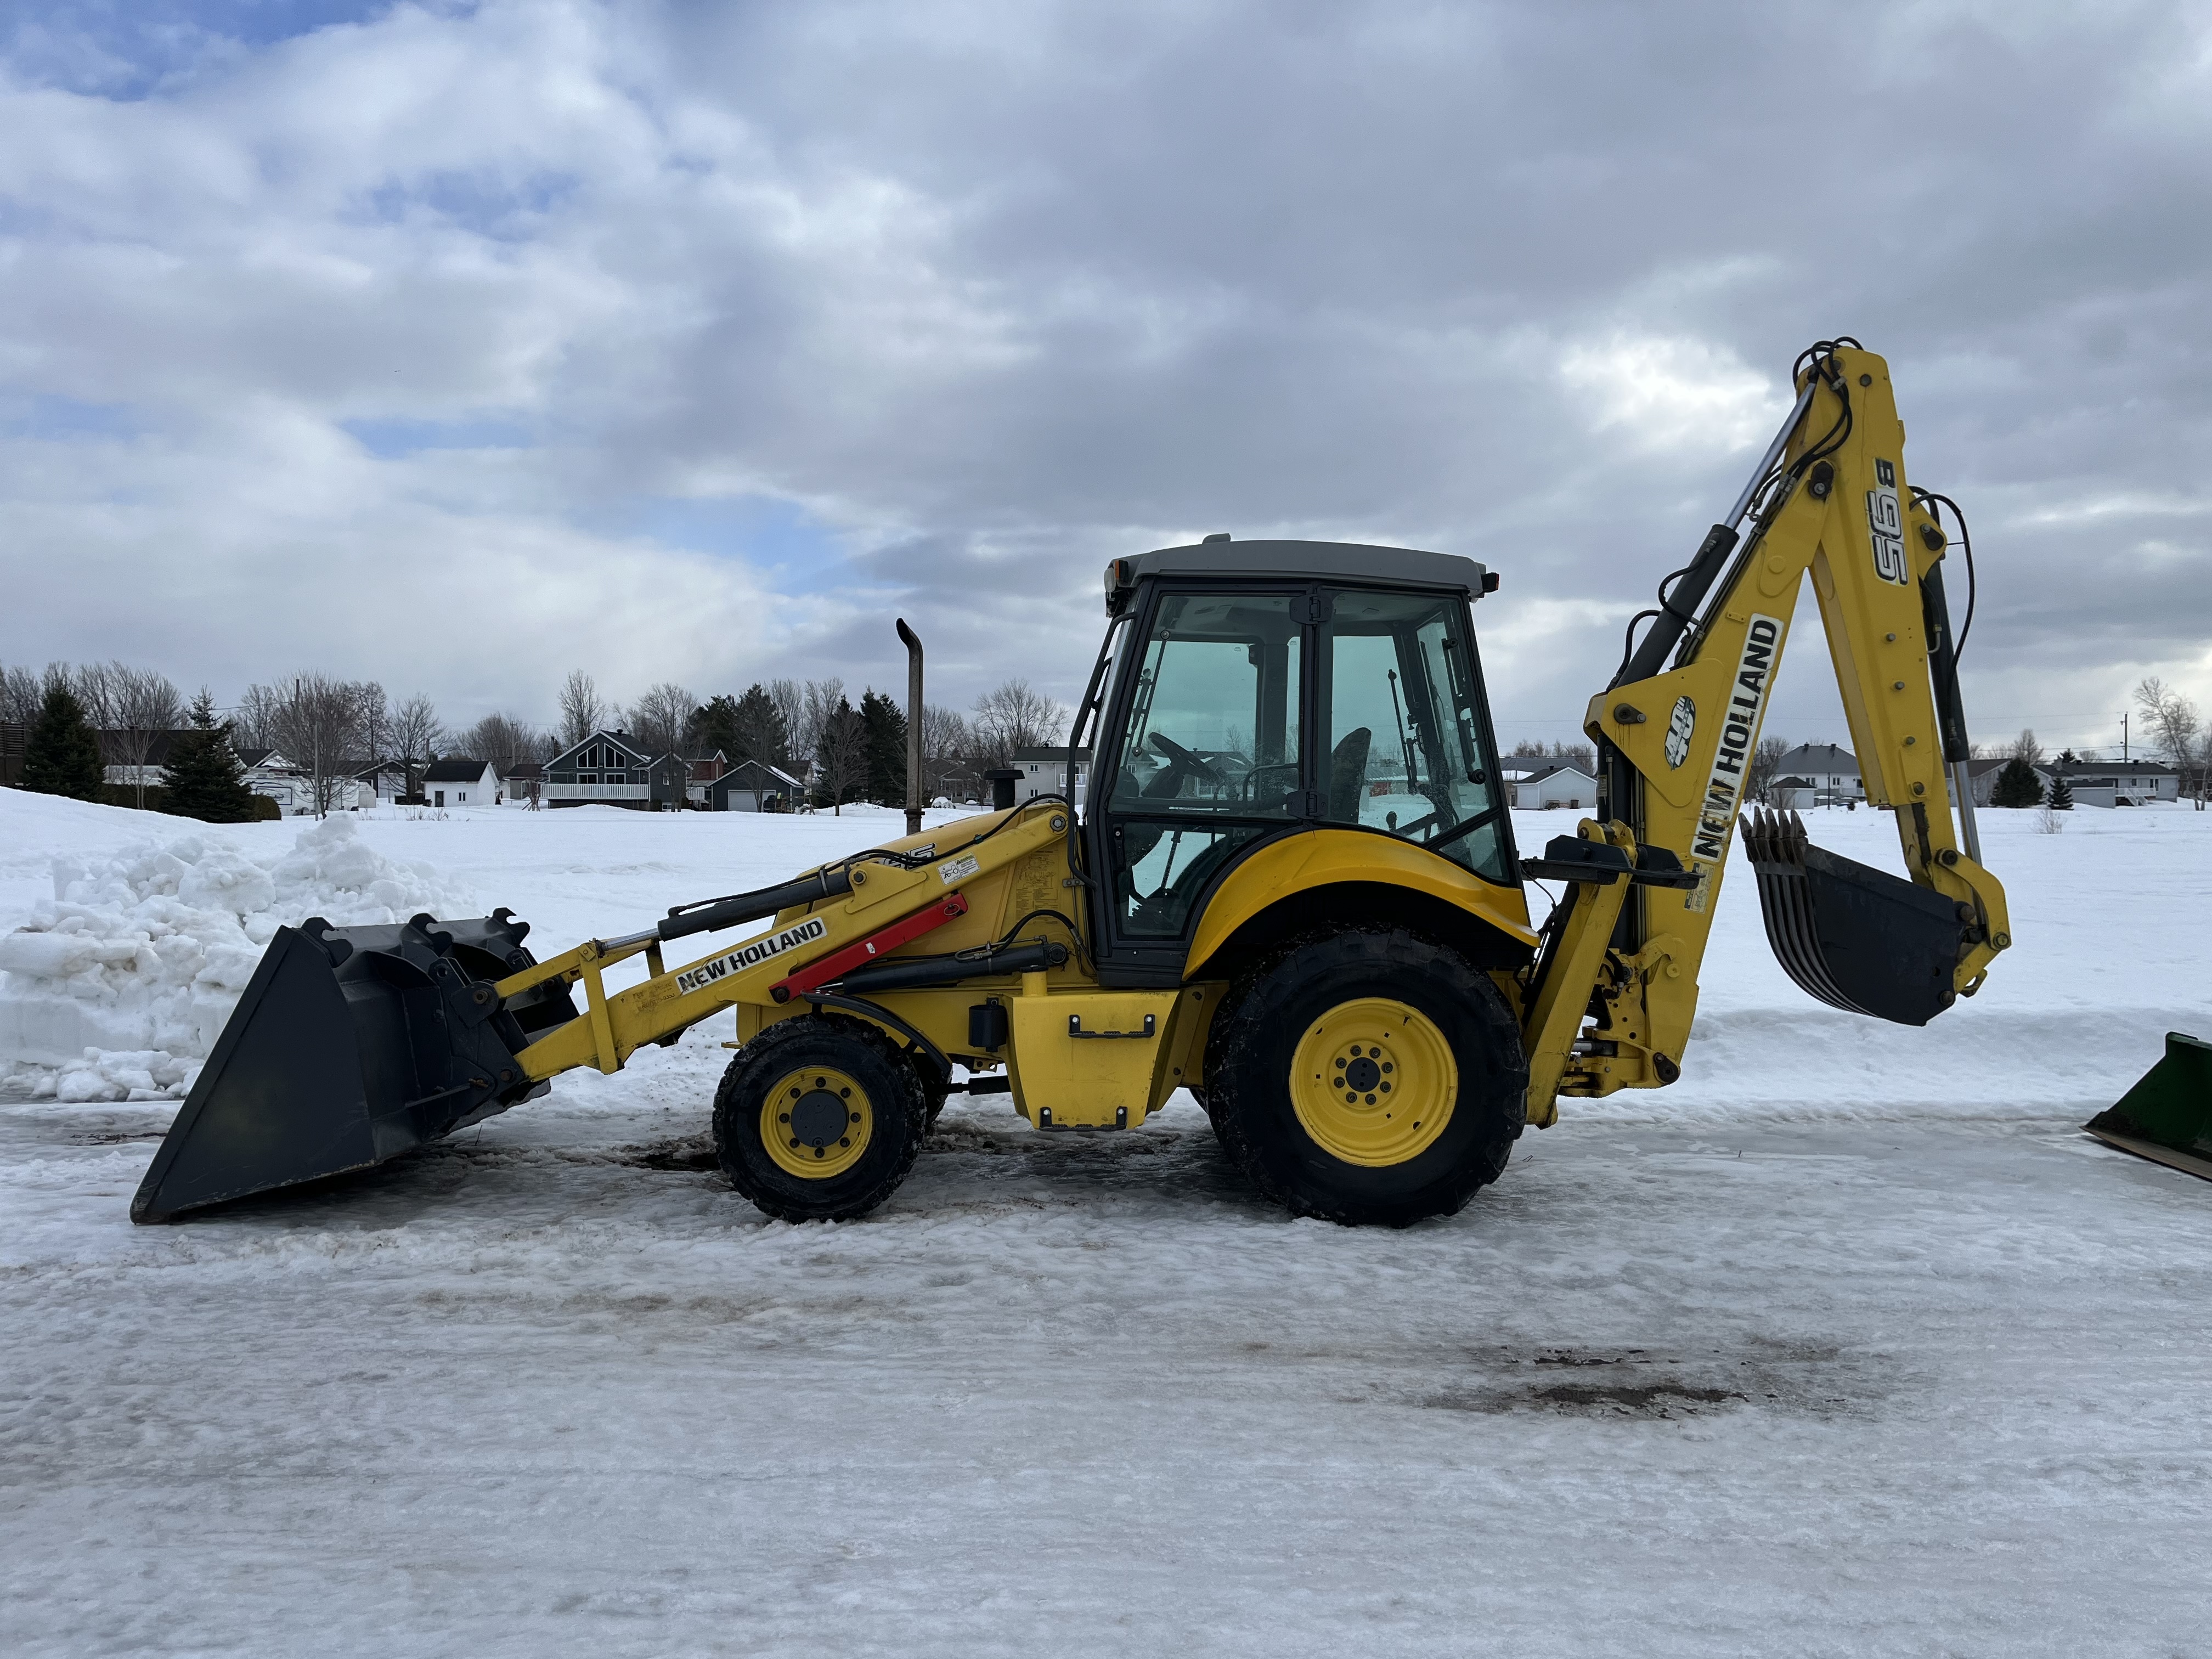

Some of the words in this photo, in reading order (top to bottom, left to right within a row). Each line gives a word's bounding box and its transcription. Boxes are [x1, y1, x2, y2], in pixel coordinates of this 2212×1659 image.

[1866, 458, 1908, 585] B95
[1694, 777, 1737, 859] NEW
[1716, 620, 1777, 775] HOLLAND
[678, 958, 727, 991] NEW
[728, 920, 823, 970] HOLLAND
